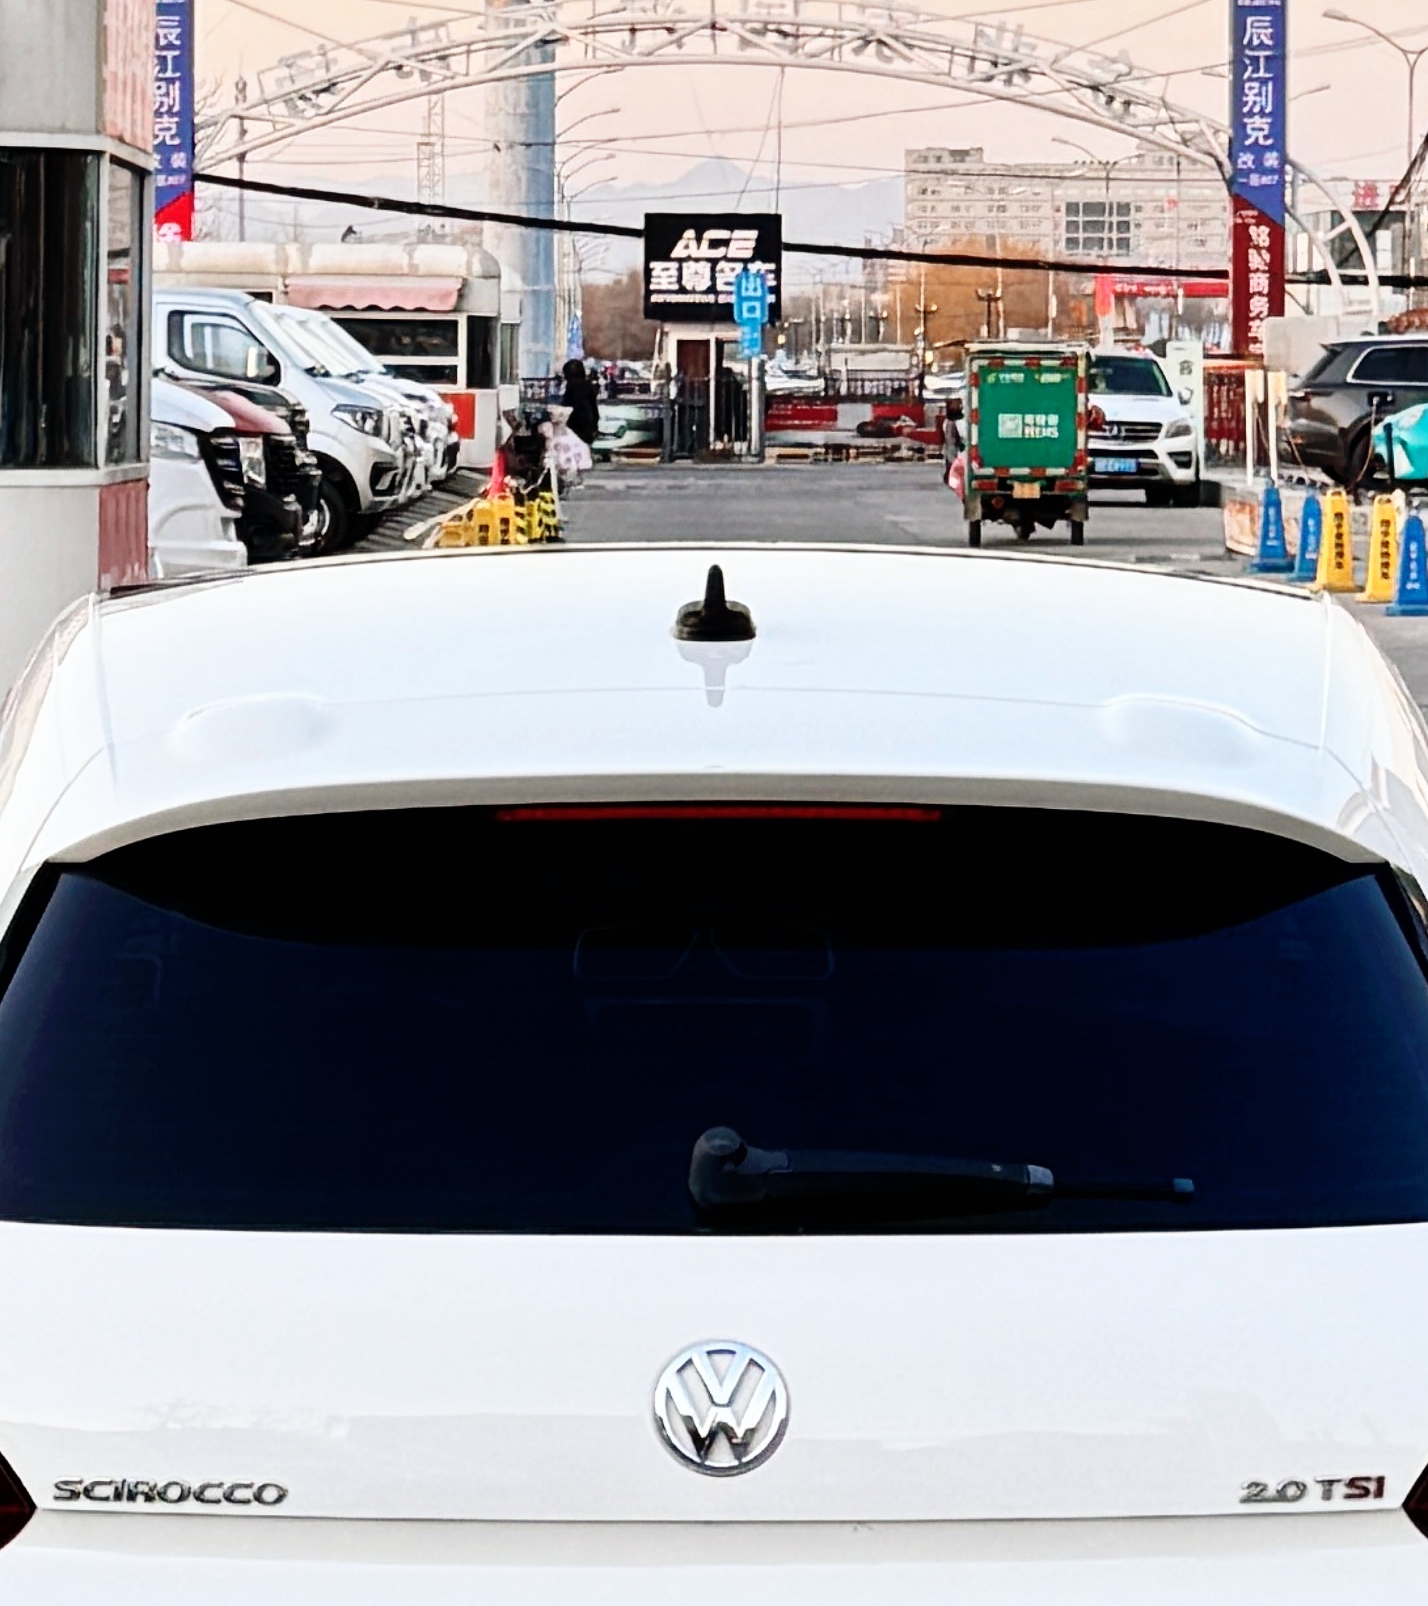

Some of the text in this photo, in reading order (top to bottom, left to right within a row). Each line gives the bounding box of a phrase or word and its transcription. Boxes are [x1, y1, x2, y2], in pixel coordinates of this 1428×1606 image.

[1242, 15, 1274, 146] 辰江别克
[670, 229, 759, 258] ACE
[52, 1477, 288, 1506] SCIROCCO
